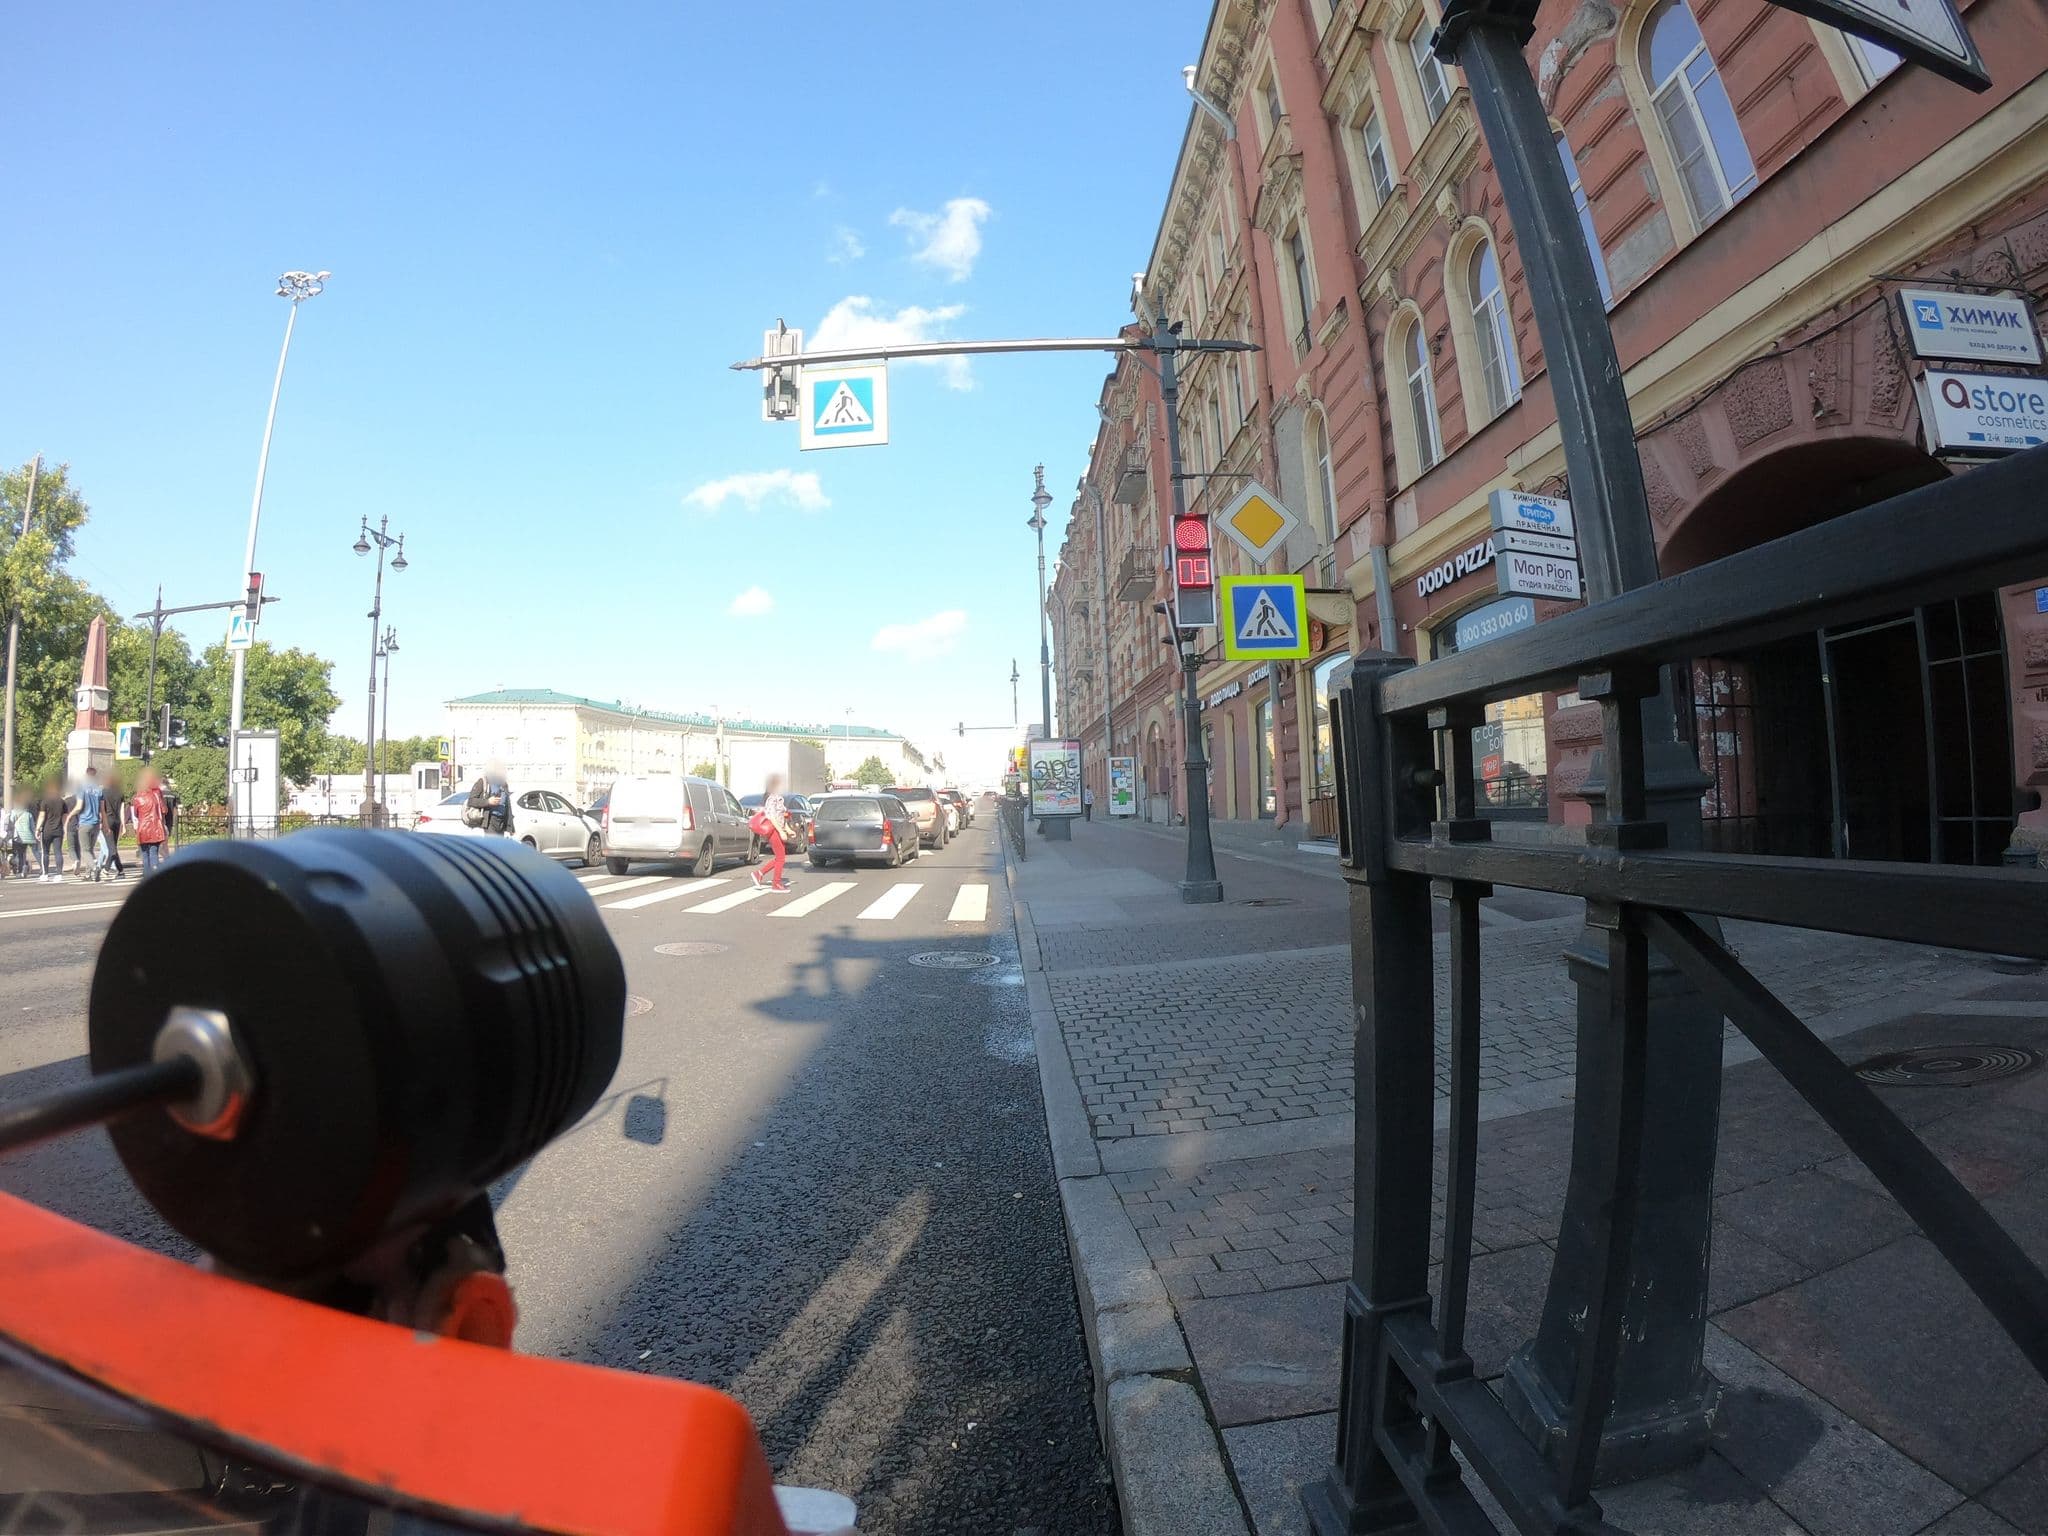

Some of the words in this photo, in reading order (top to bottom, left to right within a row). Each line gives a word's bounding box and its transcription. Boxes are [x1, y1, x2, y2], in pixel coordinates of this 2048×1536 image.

[1945, 306, 2023, 329] ХИМИК
[1977, 414, 2047, 431] cosmetics
[1512, 493, 1558, 507] ХИМЧИСТКА
[1522, 508, 1552, 520] ТРИТОН
[1516, 520, 1561, 533] ПРАЧЕЧНАЯ
[1178, 558, 1209, 585] 09
[1417, 561, 1454, 598] DODO
[1455, 538, 1497, 578] PIZZA
[1514, 559, 1544, 577] Mon
[1546, 563, 1573, 581] Pion
[1518, 579, 1542, 589] СТУДИЯ
[1543, 582, 1573, 593] КРАСОТЫ
[1462, 625, 1480, 643] 800
[1480, 618, 1498, 637] 333
[1498, 612, 1513, 629] 00
[1514, 605, 1528, 622] 60
